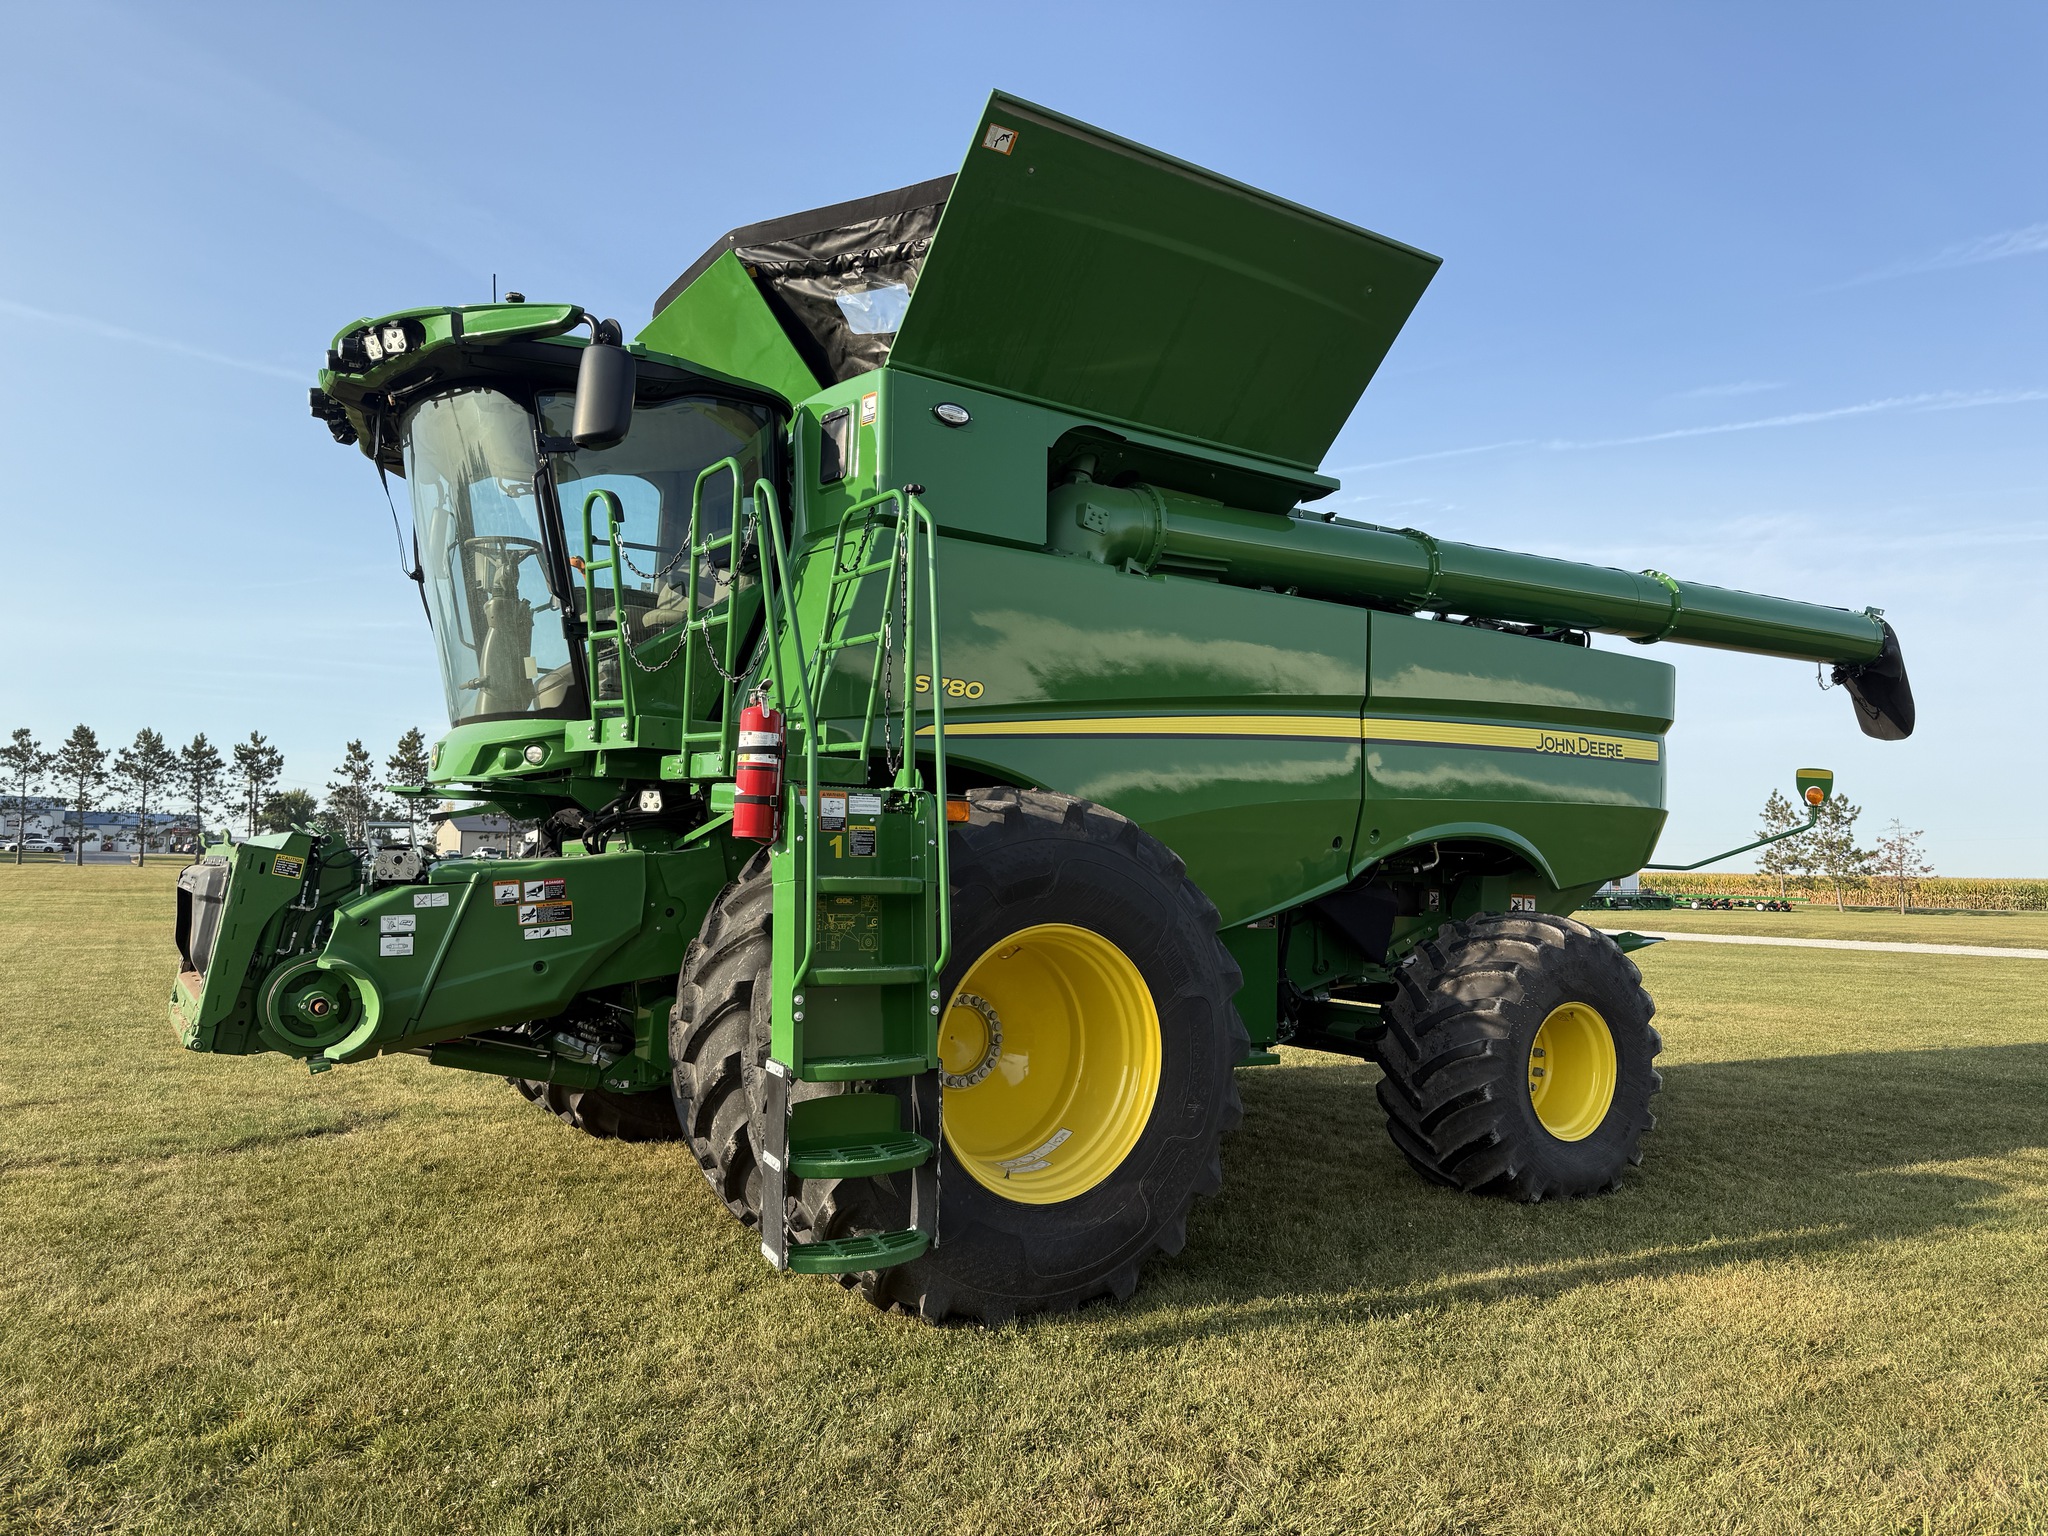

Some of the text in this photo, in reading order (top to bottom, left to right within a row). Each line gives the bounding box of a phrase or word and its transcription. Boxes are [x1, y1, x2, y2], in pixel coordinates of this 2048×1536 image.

[1536, 732, 1624, 757] JOHN DEERE
[282, 855, 303, 863] CAUTION
[829, 835, 843, 859] 1
